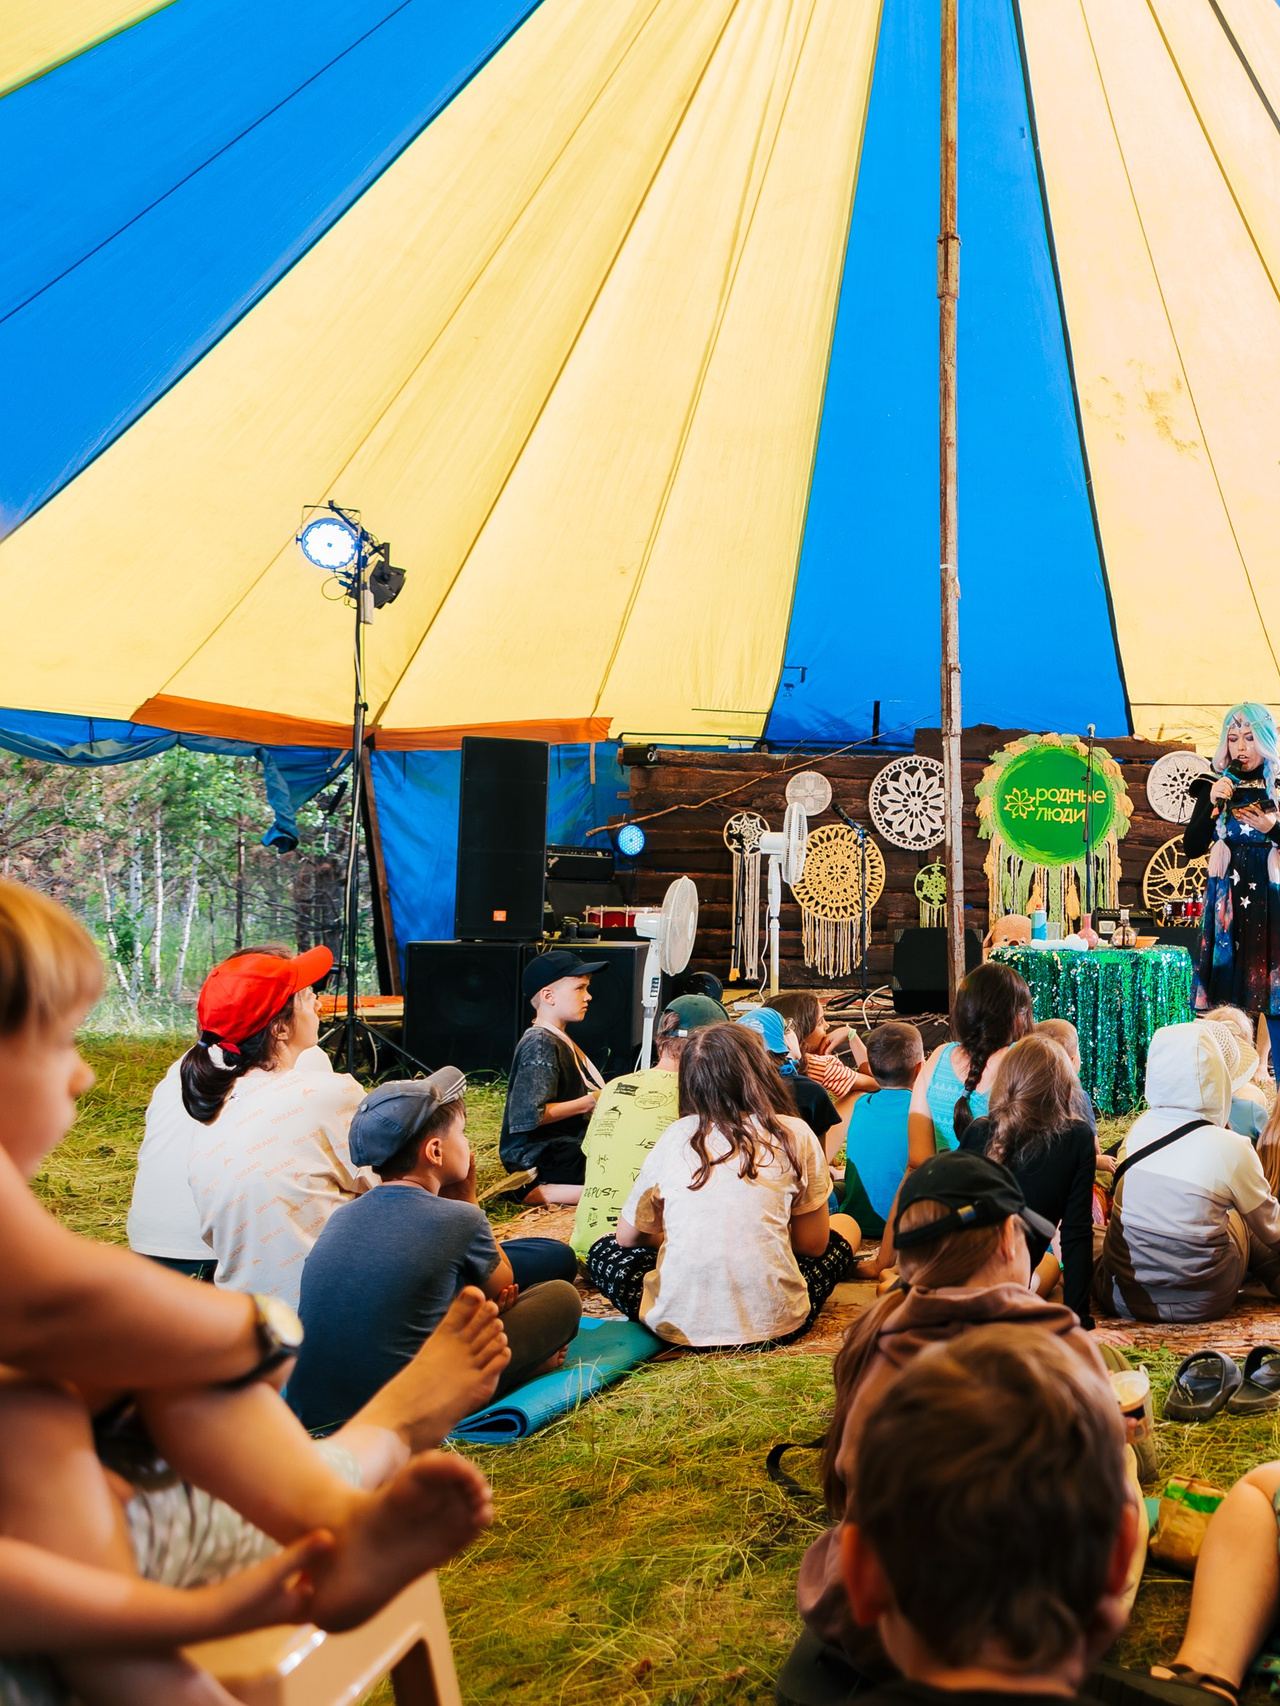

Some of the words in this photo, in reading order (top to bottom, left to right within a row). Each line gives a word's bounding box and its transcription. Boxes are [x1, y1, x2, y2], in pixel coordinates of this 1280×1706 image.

[1036, 807, 1086, 824] люди
[271, 1106, 304, 1124] DREAMS
[246, 1135, 279, 1154] DREAMS
[235, 1161, 263, 1180] DREAMS
[264, 1157, 296, 1178] DREAMS
